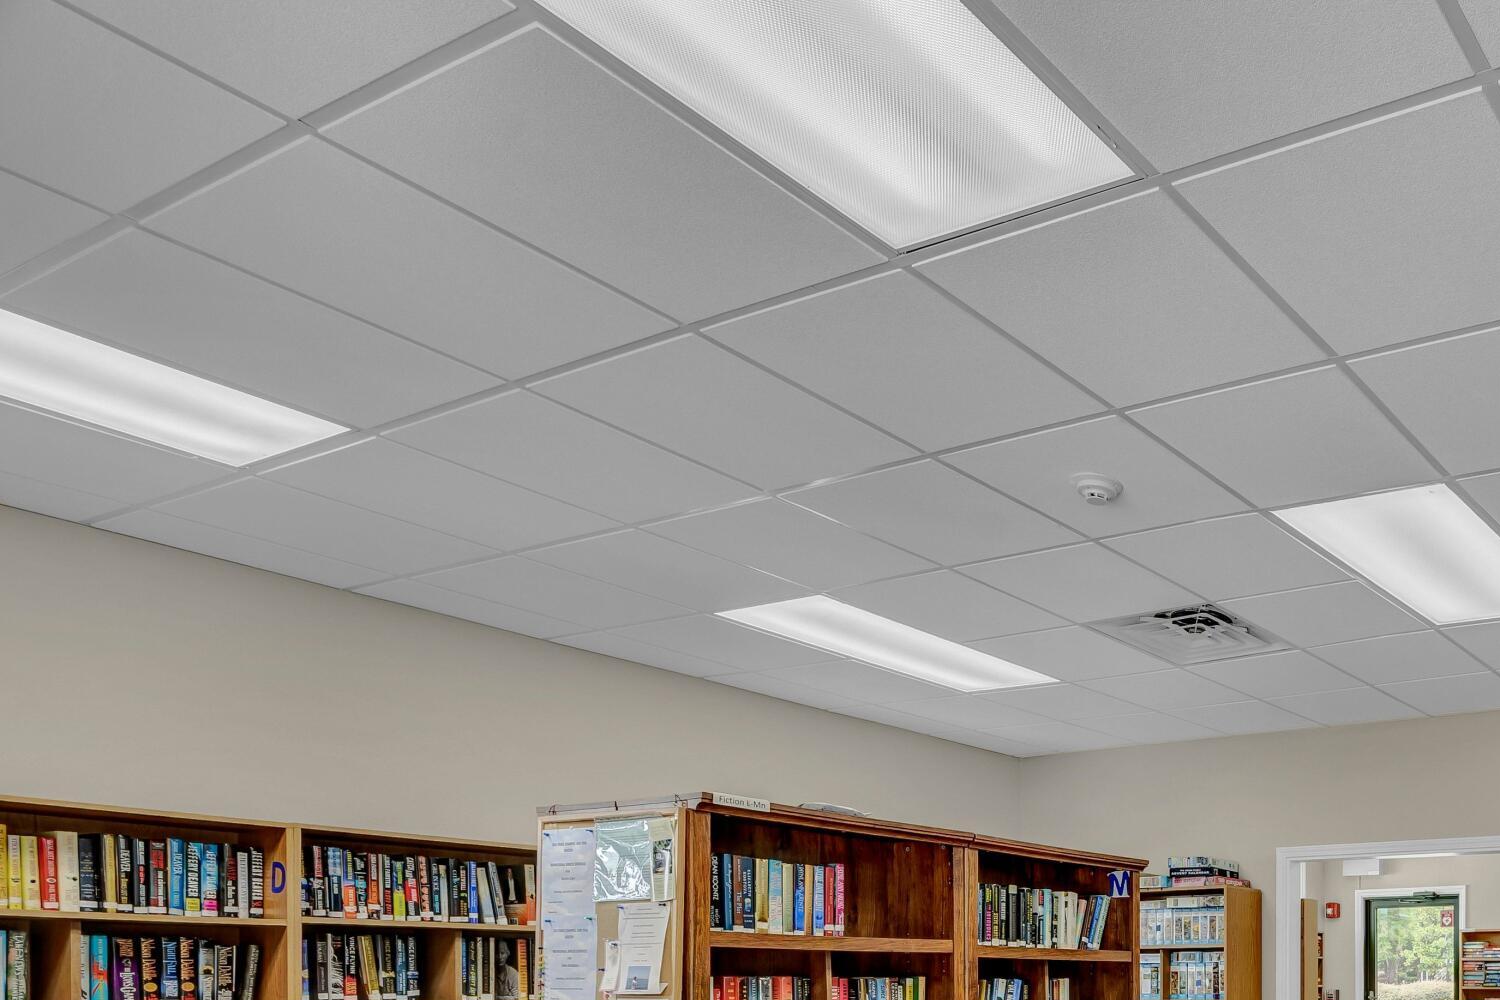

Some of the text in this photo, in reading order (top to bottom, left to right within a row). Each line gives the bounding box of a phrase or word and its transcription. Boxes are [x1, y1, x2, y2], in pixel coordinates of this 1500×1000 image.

[120, 850, 131, 872] DEAVER
[174, 853, 183, 875] DEAVER
[187, 845, 199, 897] JEFFERY DEAVER
[206, 850, 217, 899] JEFFERY DEAVER
[252, 851, 263, 901] JEFFERY DEAVER
[271, 862, 286, 894] D
[711, 856, 719, 874] DEAN
[141, 938, 158, 981] Nelson DeMille
[179, 939, 195, 981] Nelson DeMille
[218, 946, 233, 987] Nelson DeMille
